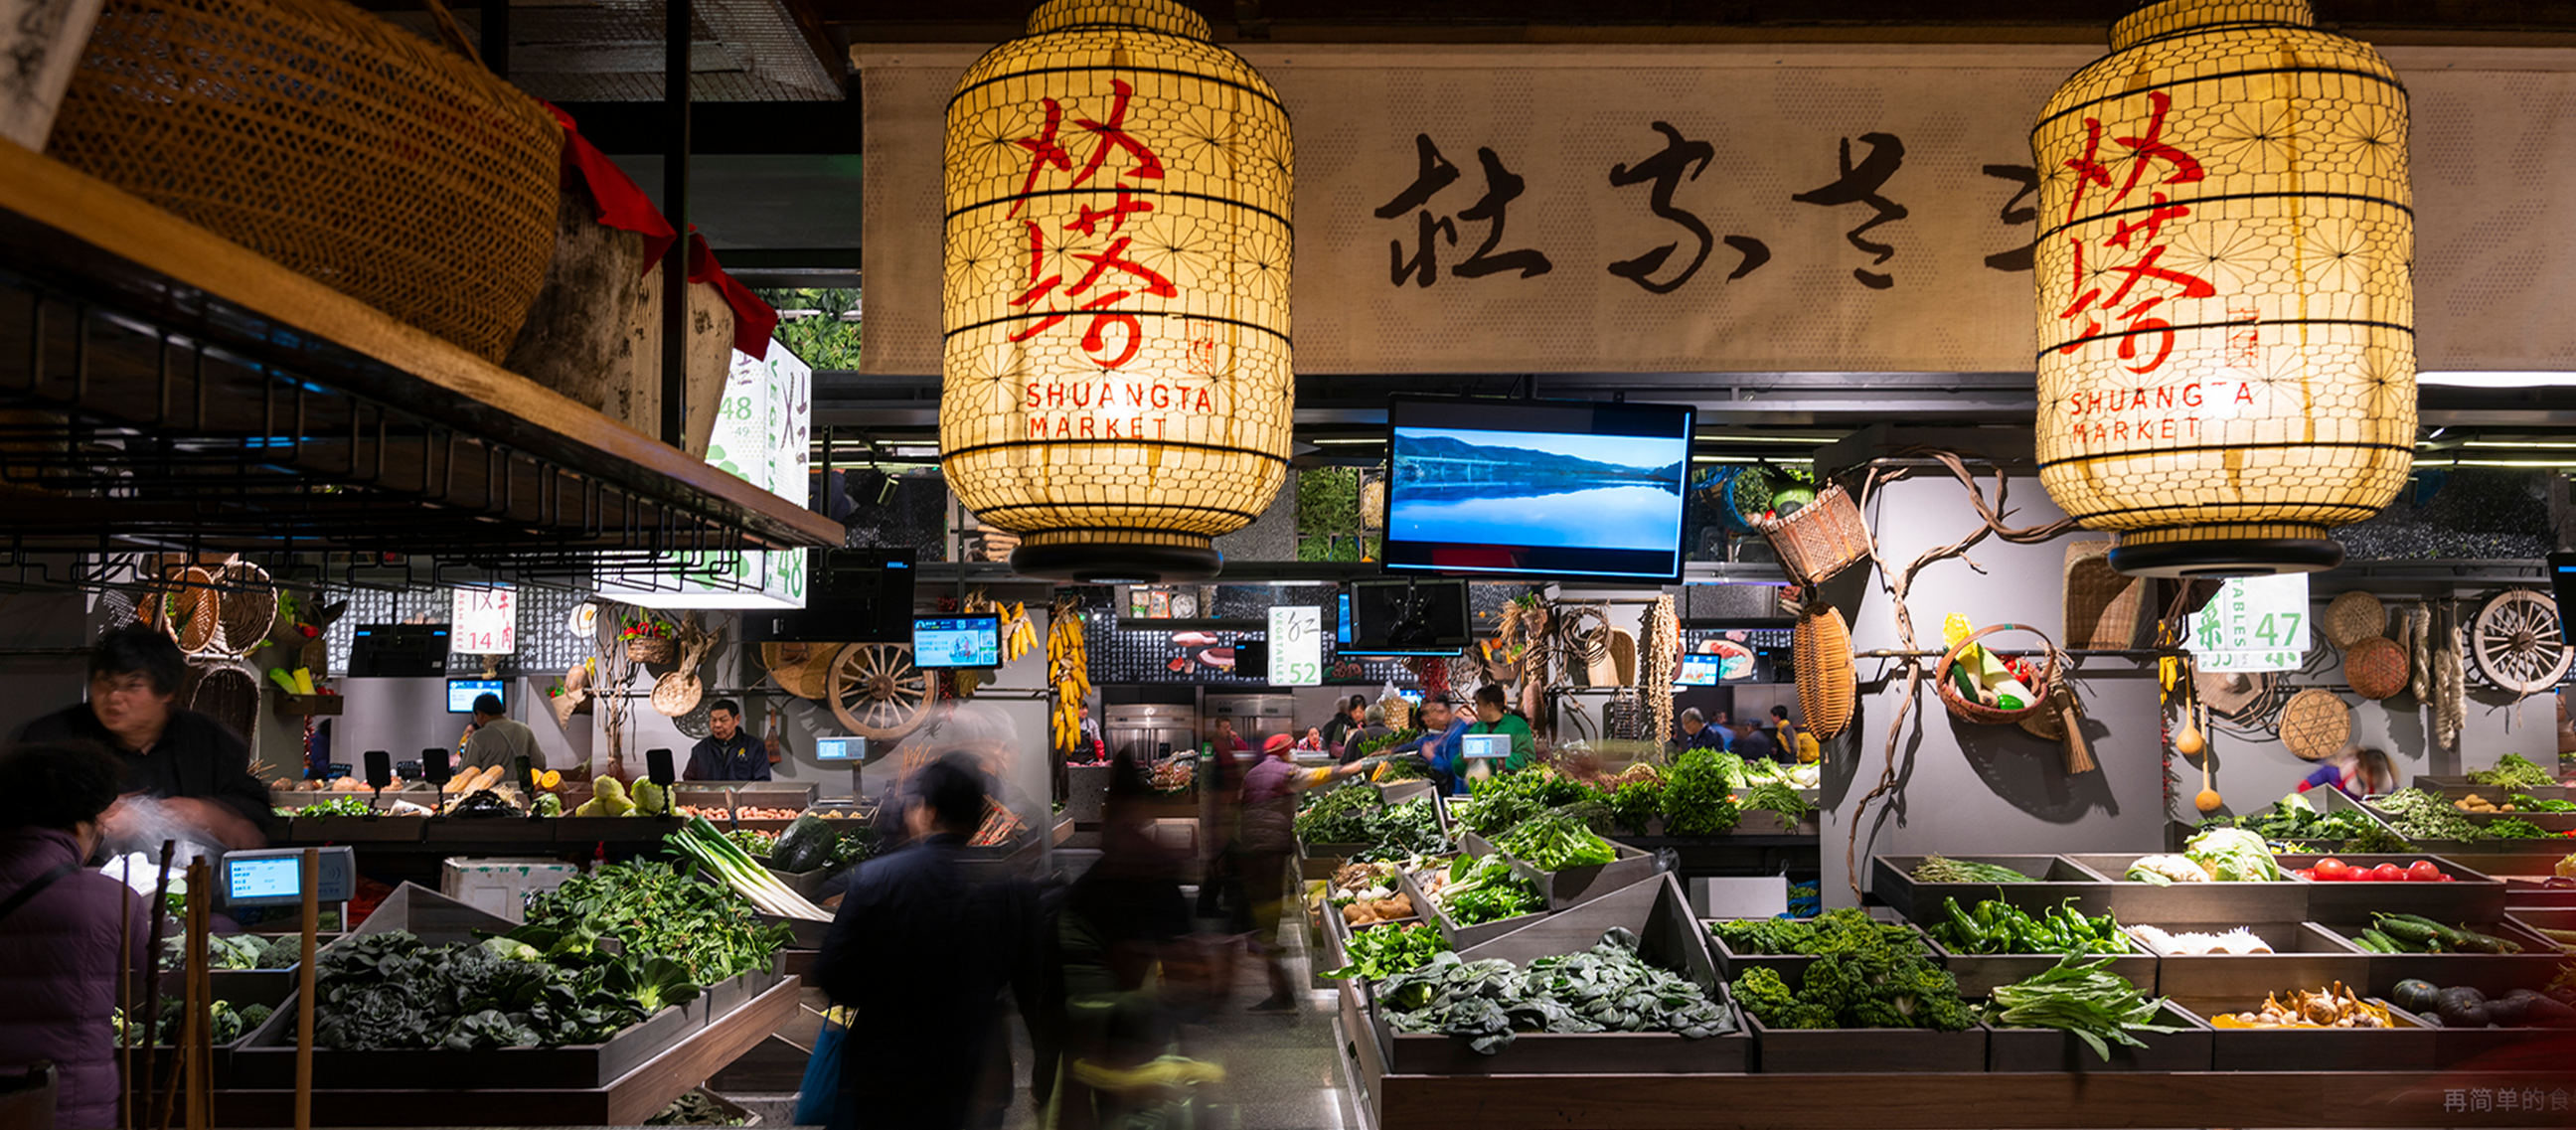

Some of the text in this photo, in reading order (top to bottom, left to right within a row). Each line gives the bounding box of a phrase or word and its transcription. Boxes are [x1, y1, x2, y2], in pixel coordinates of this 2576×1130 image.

[719, 397, 752, 420] 48
[1027, 383, 1212, 412] SHUANGTA
[1030, 417, 1167, 440] MARKET
[2073, 417, 2199, 443] MARKET
[777, 547, 803, 598] 48
[470, 632, 491, 649] 14
[2255, 612, 2302, 646] 47
[1275, 611, 1284, 684] VEGETABLES
[1289, 663, 1317, 684] 52
